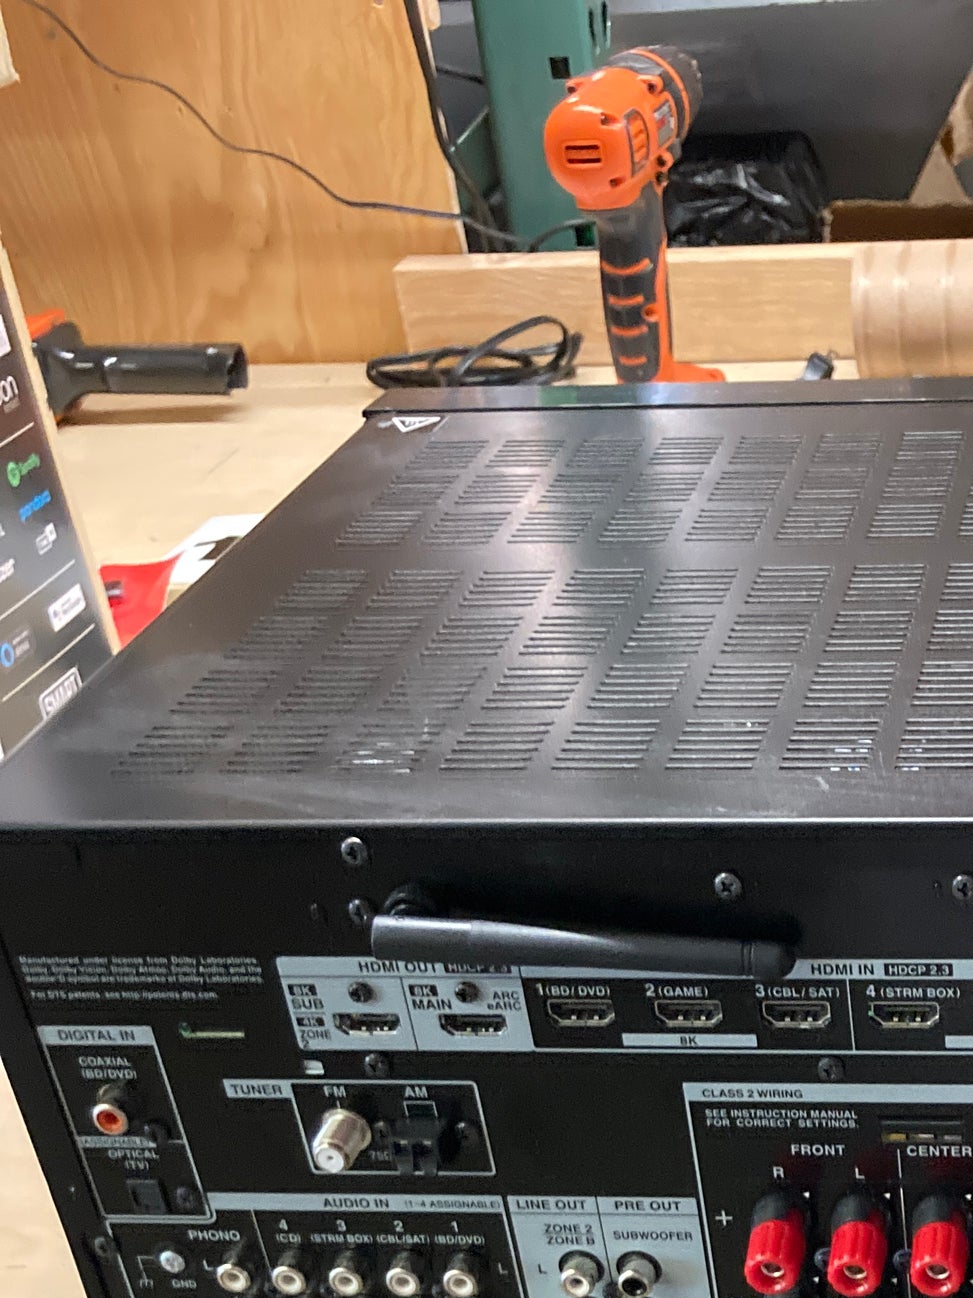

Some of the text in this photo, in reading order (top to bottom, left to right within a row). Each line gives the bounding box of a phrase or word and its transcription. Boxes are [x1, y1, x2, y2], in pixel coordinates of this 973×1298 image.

[358, 961, 400, 974] HDMI
[404, 961, 437, 974] OUT
[810, 963, 950, 976] HDMI IN HDCP 2.3
[492, 990, 520, 1000] ARC
[535, 983, 544, 996] 1
[645, 984, 709, 998] 2 (GAME)
[755, 984, 765, 997] 3
[865, 984, 961, 999] 4 (STRM BOX)
[291, 998, 324, 1010] SUB
[411, 998, 453, 1010] MAIN
[487, 1001, 522, 1011] eARC
[57, 1030, 136, 1041] DIGITAL IN
[79, 1056, 132, 1067] COAXIAL
[229, 1083, 283, 1095] TUNER
[323, 1086, 347, 1098] FM
[404, 1086, 428, 1098] AM
[702, 1088, 803, 1099] CLASS 2 WIRING
[704, 1108, 858, 1120] SEE INSTRUCTION MANUAL
[706, 1118, 860, 1129] FOR CORRECT SETTINGS.
[790, 1144, 846, 1156] FRONT
[906, 1145, 973, 1158] CENTER
[772, 1166, 865, 1180] R L
[323, 1198, 372, 1209] AUDIO
[375, 1198, 390, 1209] IN
[516, 1199, 587, 1211] LINE OUT
[614, 1201, 681, 1211] PRE OUT
[278, 1219, 288, 1231] 4
[336, 1220, 347, 1232] 3
[393, 1220, 405, 1233] 2
[450, 1221, 459, 1233] 1
[544, 1223, 593, 1234] ZONE 2
[187, 1229, 241, 1242] PHONO
[434, 1235, 486, 1246] (BD/DVD)
[546, 1236, 580, 1246] ZONE
[613, 1230, 693, 1242] SUBWOOFER
[498, 1262, 509, 1276] L
[537, 1264, 548, 1275] L
[171, 1279, 197, 1289] GND
